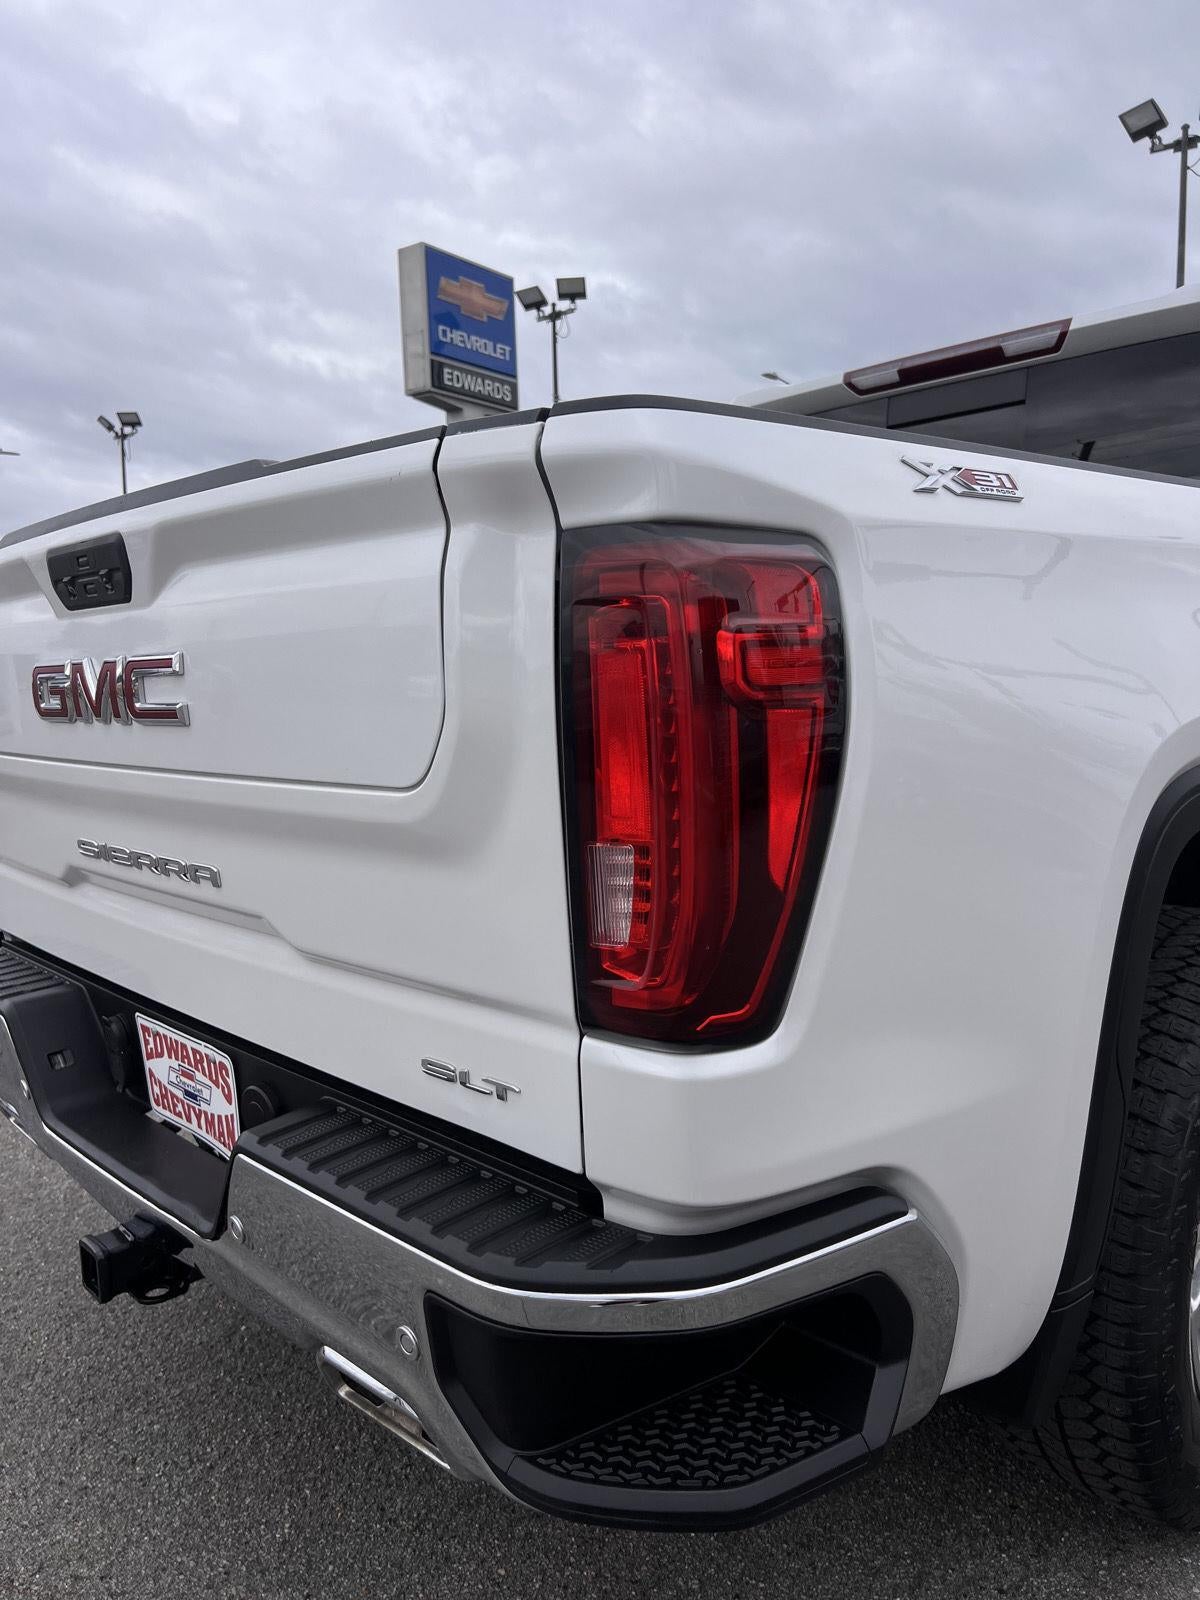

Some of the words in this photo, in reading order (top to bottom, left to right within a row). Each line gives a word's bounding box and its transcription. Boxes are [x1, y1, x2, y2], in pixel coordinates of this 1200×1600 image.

[437, 325, 512, 361] CHEVROLET
[443, 367, 512, 401] EDWARDS
[980, 486, 995, 494] OFF
[995, 488, 1017, 496] ROAD
[32, 650, 190, 727] GMC
[77, 837, 222, 888] SIERRA
[140, 1023, 233, 1106] EDWARDS
[420, 1057, 521, 1102] SLT
[148, 1067, 237, 1151] CHEVYMAN
